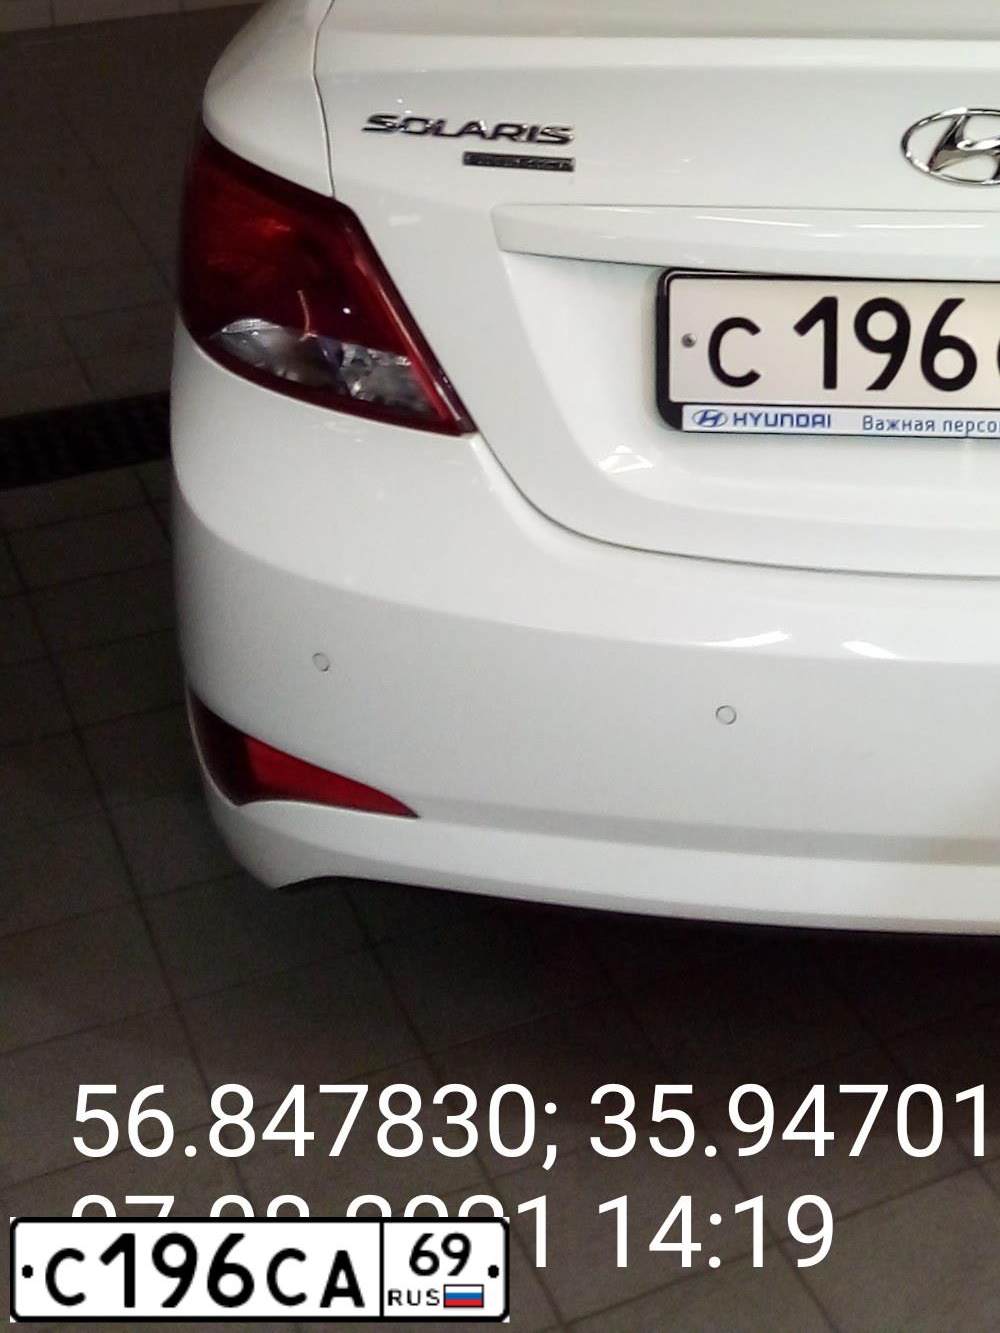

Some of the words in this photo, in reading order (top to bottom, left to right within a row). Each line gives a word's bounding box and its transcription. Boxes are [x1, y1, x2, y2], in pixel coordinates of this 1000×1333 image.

[361, 114, 575, 146] SOLARIS
[732, 412, 832, 429] HYUNDAI
[862, 414, 936, 432] Важная
